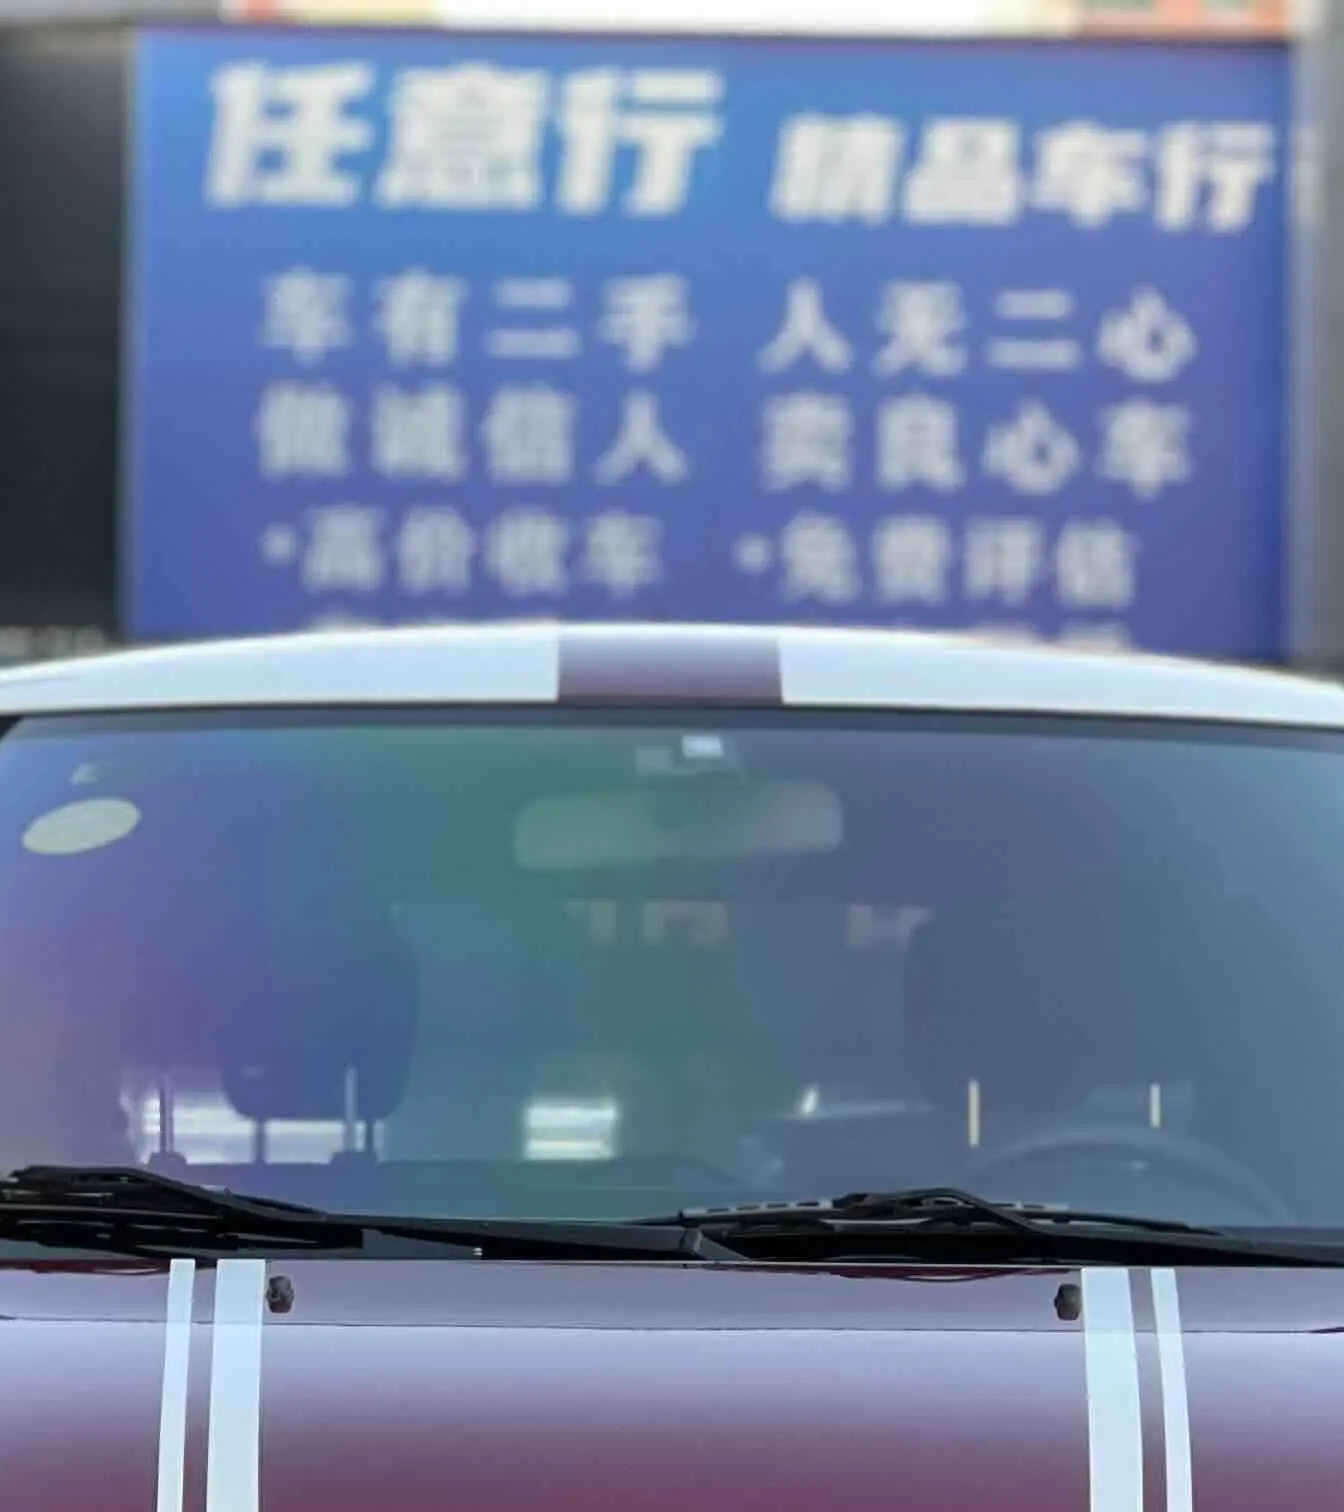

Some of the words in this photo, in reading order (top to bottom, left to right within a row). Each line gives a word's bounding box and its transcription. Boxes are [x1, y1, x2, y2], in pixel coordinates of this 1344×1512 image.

[204, 60, 726, 217] 任意行
[769, 112, 1278, 235] 精品车行
[261, 268, 696, 366] 车有二手
[759, 280, 1199, 385] 人无二心
[256, 384, 690, 482] 做诚信人
[759, 393, 1194, 498] 卖良心车
